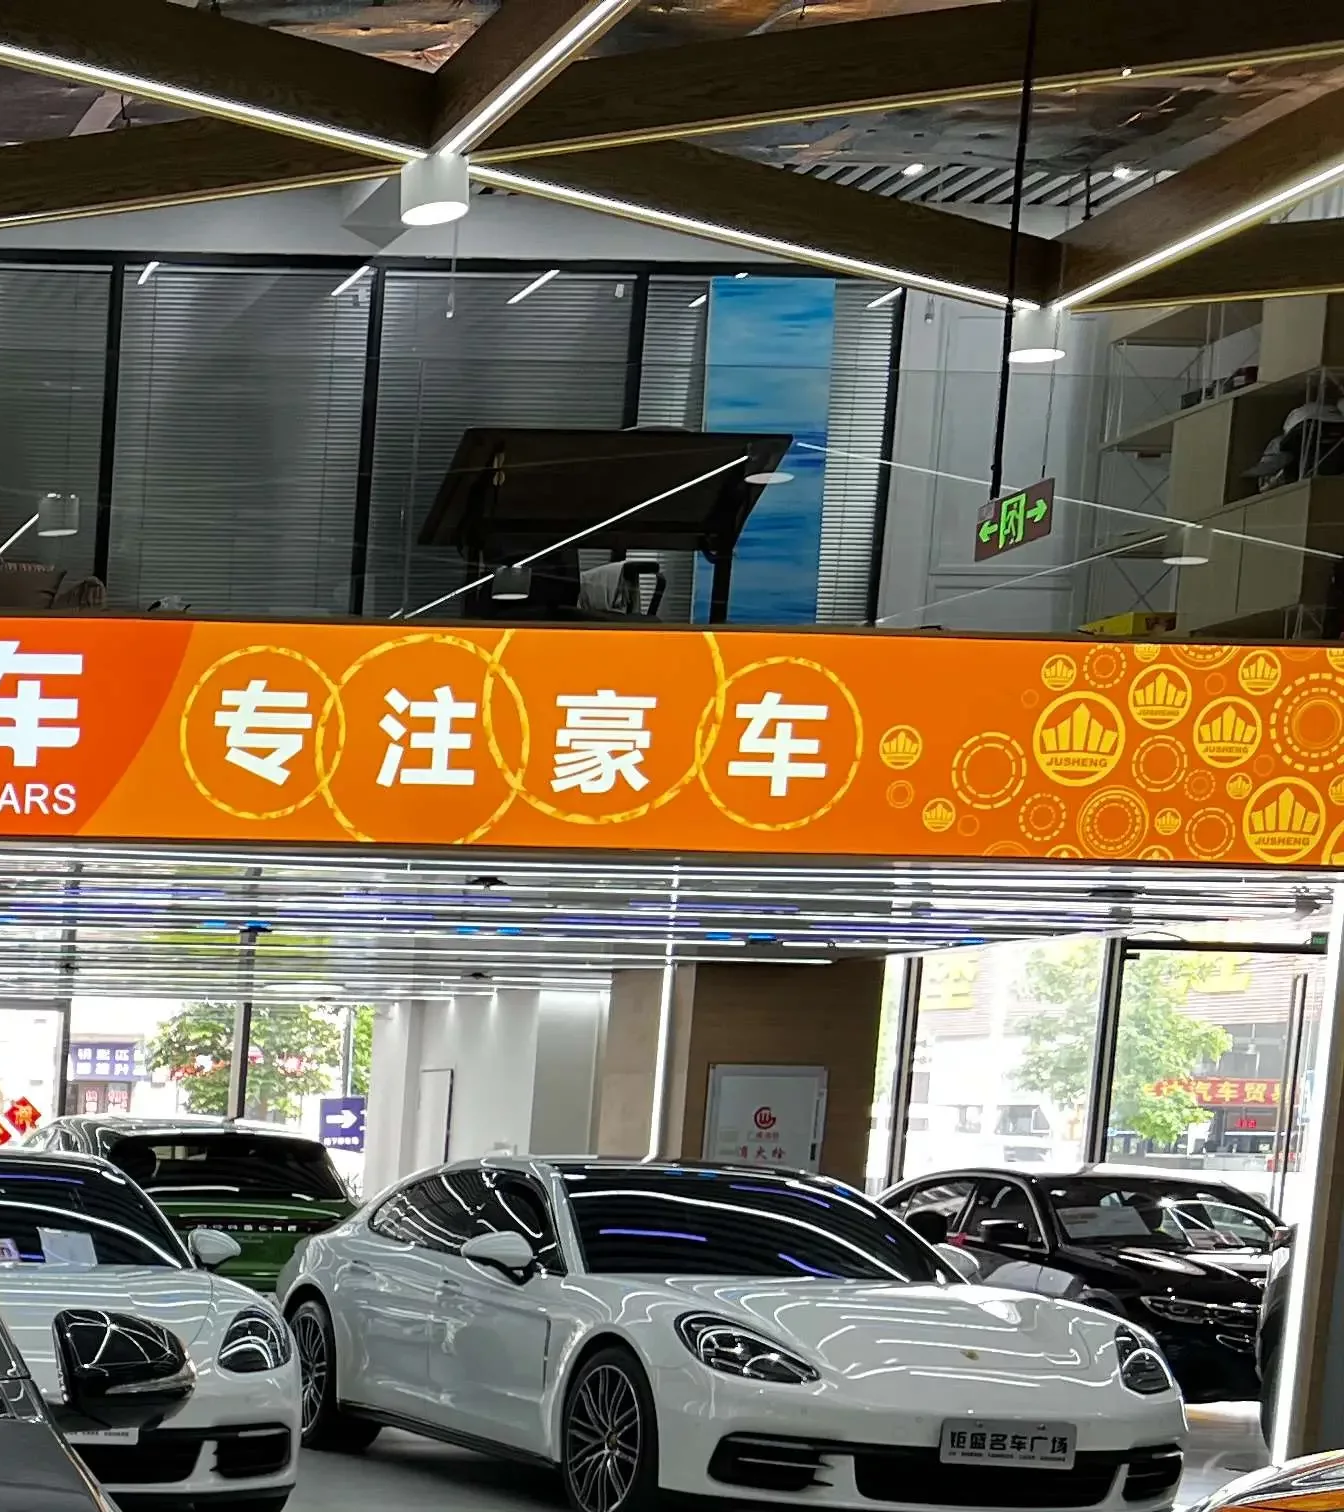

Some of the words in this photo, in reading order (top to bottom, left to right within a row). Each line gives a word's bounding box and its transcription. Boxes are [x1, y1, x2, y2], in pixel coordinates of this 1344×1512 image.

[213, 679, 830, 798] 专注豪车
[1045, 756, 1109, 769] JUSHENG
